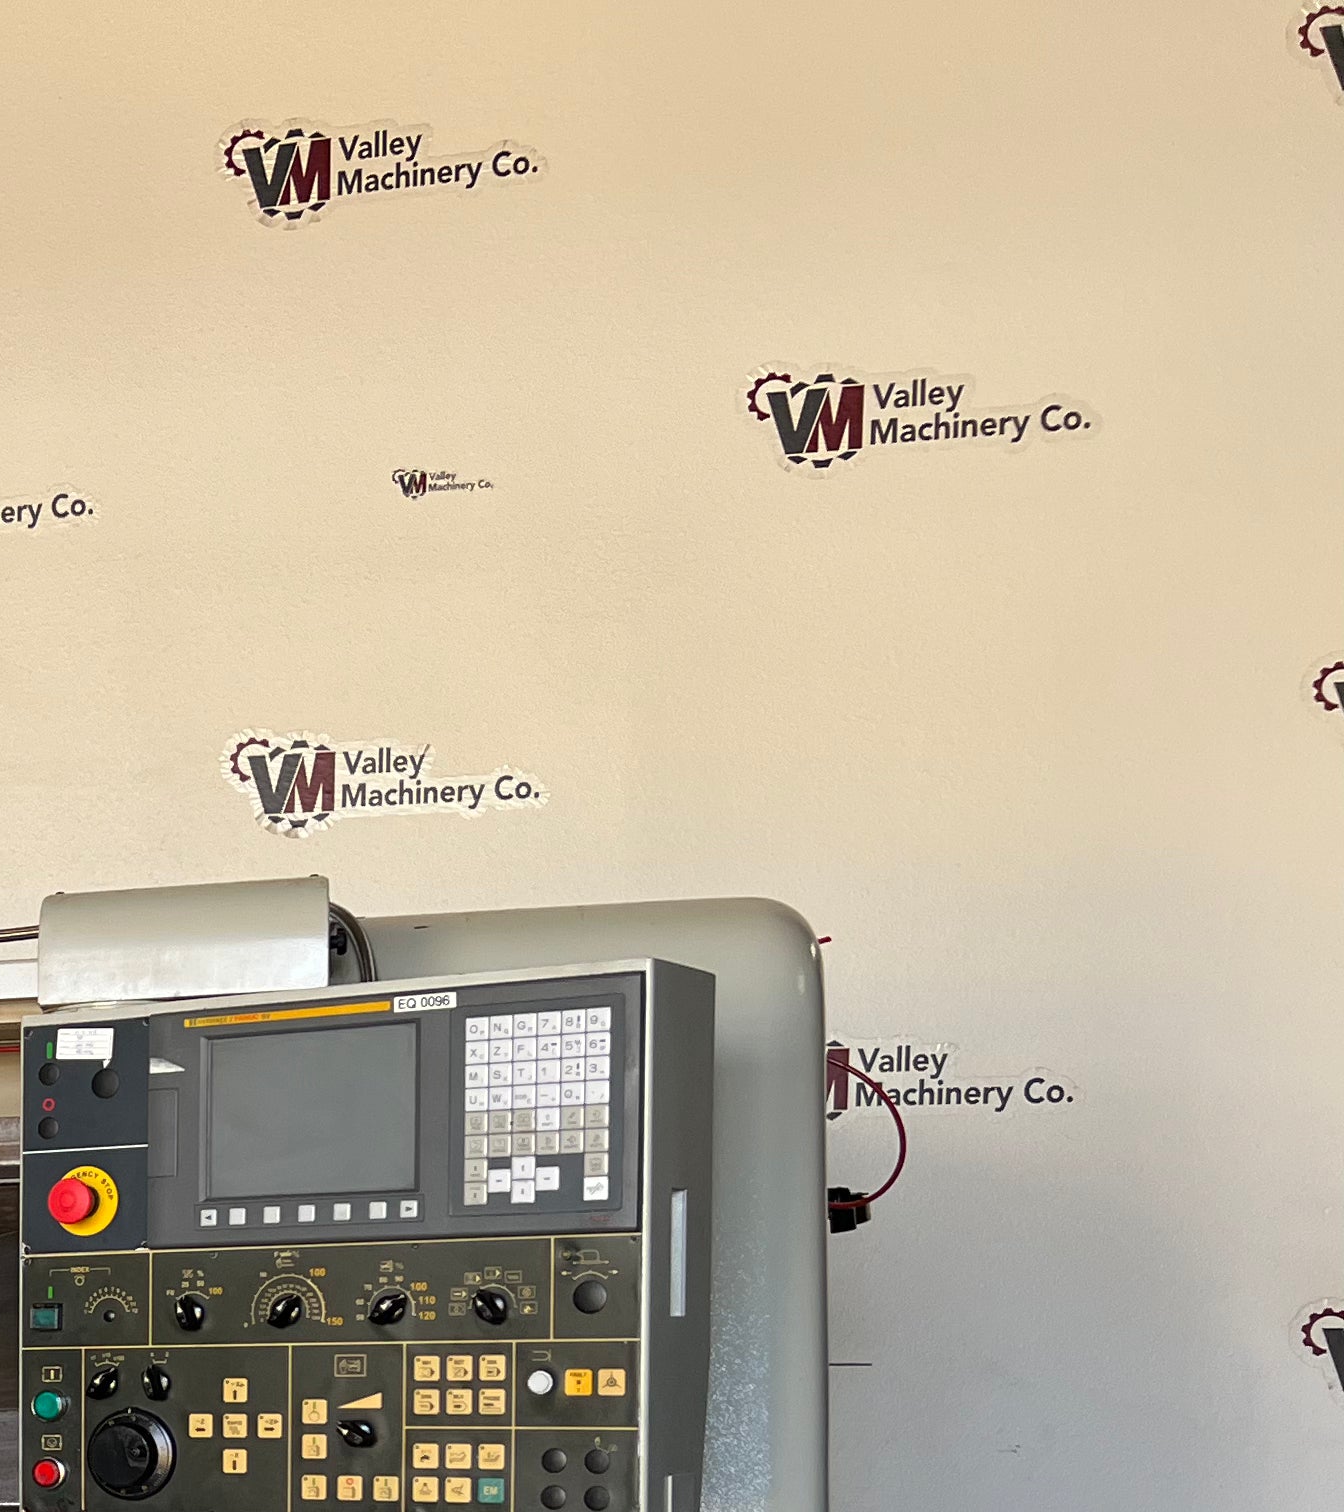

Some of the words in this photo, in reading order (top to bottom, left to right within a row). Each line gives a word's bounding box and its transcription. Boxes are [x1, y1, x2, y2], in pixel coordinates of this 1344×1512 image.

[338, 130, 422, 162] Valley
[242, 139, 332, 208] VM
[337, 161, 483, 196] Machinery
[492, 151, 538, 177] Co.
[873, 378, 965, 413] Valley
[766, 385, 865, 455] VM
[870, 412, 1031, 445] Machinery
[1041, 405, 1091, 432] Co.
[51, 493, 93, 518] Co.
[342, 744, 427, 780] Valley
[247, 751, 336, 815] VM
[341, 779, 485, 810] Machinery
[494, 775, 539, 800] Co.
[398, 998, 417, 1009] EQ
[420, 995, 450, 1007] 0096
[858, 1045, 948, 1079] Valley
[855, 1079, 1014, 1112] Machinery
[1024, 1077, 1073, 1104] Co.
[100, 1178, 114, 1201] STOP
[309, 1268, 326, 1277] 100
[410, 1282, 428, 1291] 100
[209, 1287, 223, 1296] 100
[419, 1296, 436, 1304] 110
[326, 1317, 343, 1326] 150
[419, 1311, 436, 1320] 120
[483, 1486, 498, 1496] EM
